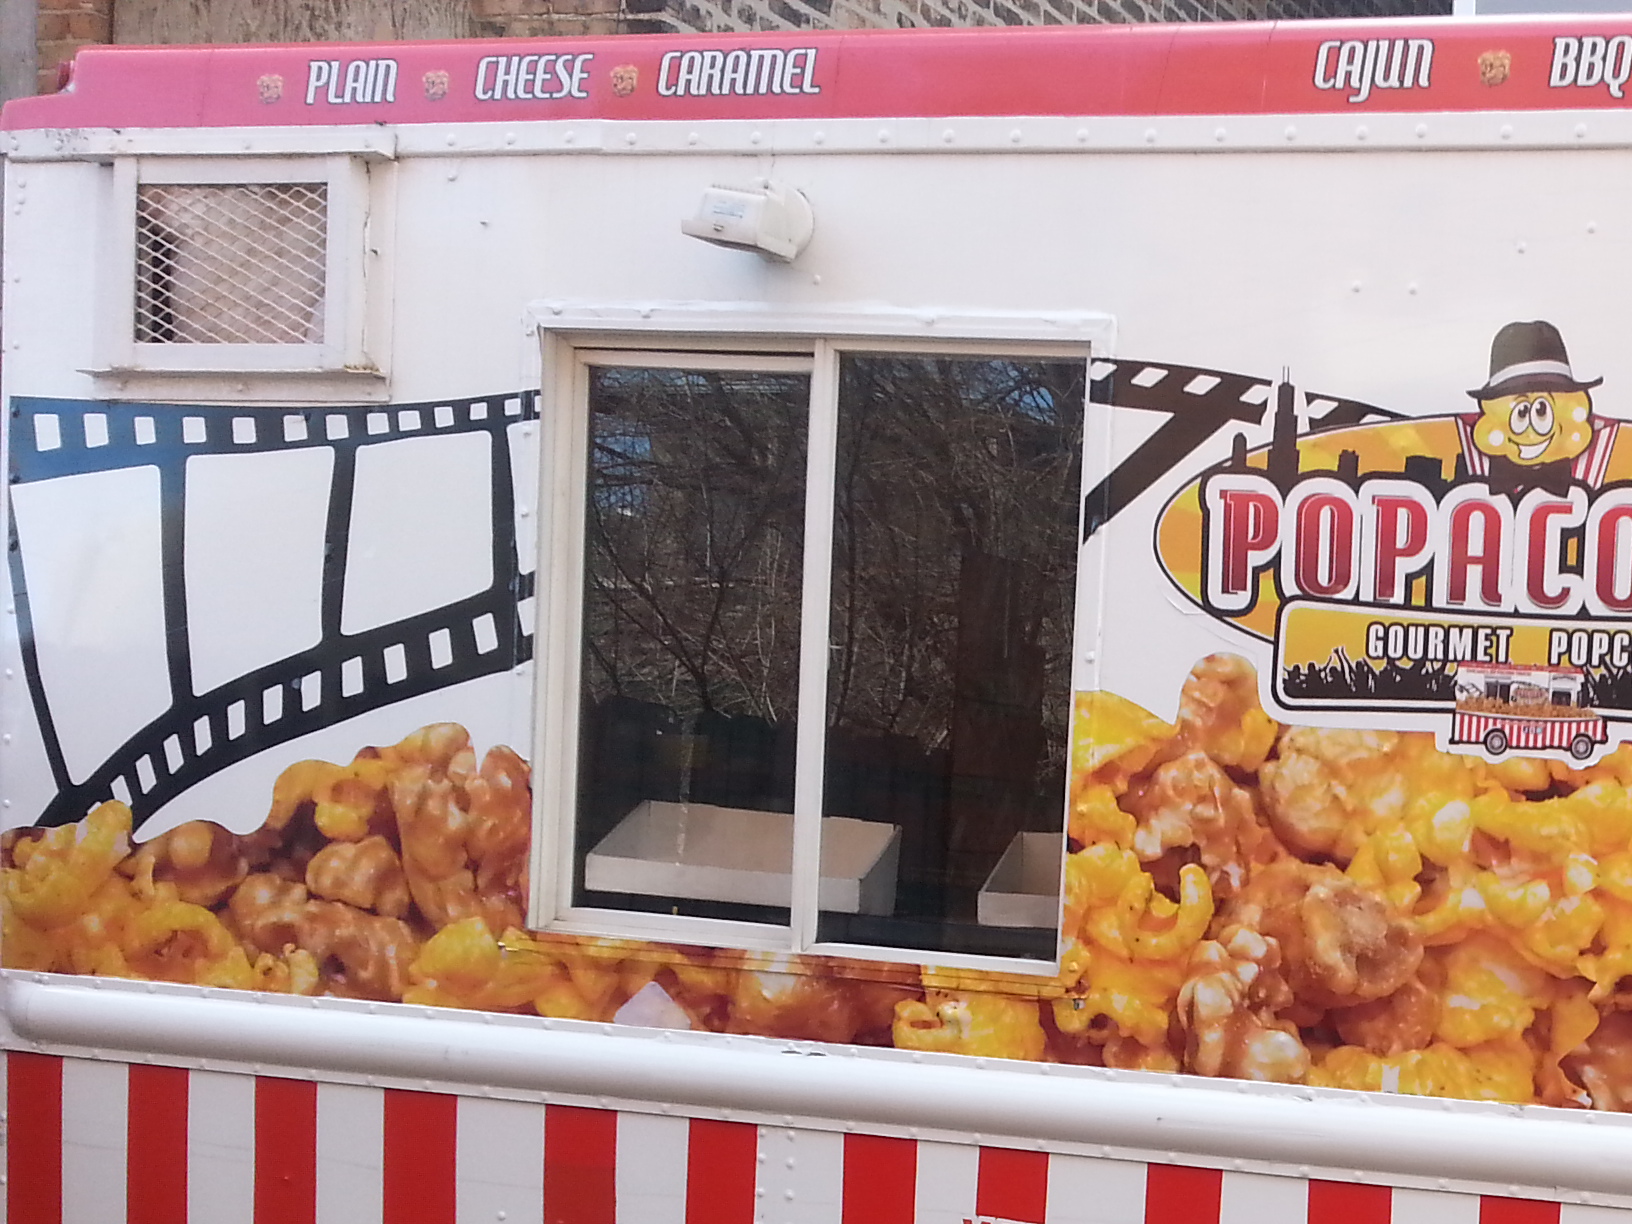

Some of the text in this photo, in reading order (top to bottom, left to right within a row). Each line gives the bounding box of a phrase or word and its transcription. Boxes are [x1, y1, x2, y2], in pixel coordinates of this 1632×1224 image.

[304, 48, 821, 104] PLAIN CHEESE CARAMEL
[1313, 38, 1434, 103] CAJUN
[1367, 623, 1513, 664] GOURMET
